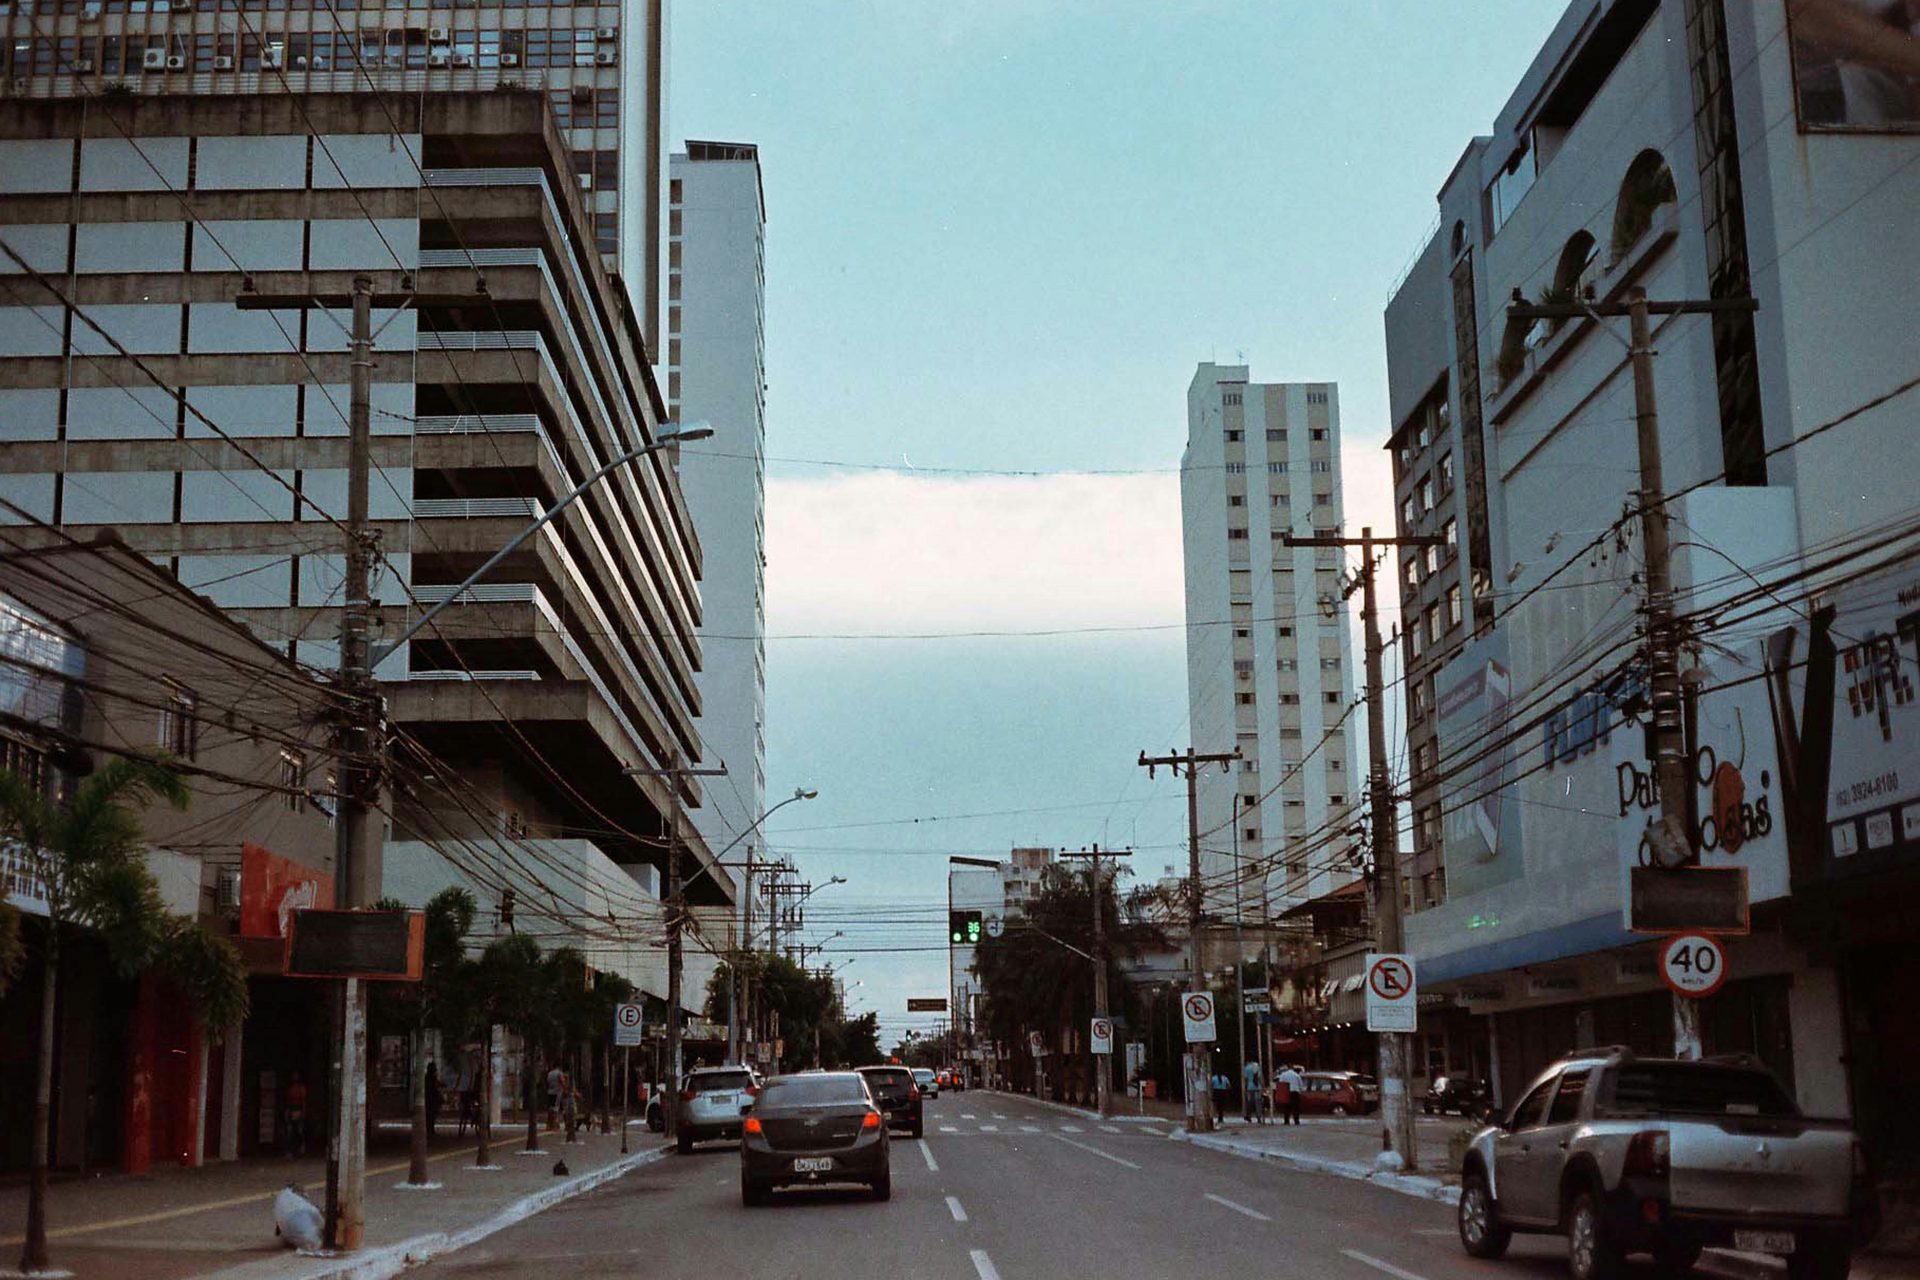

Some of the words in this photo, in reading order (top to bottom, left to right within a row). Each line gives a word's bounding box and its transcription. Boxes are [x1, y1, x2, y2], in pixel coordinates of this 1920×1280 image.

[967, 921, 980, 933] 36
[1671, 945, 1715, 973] 40
[626, 1009, 635, 1023] E
